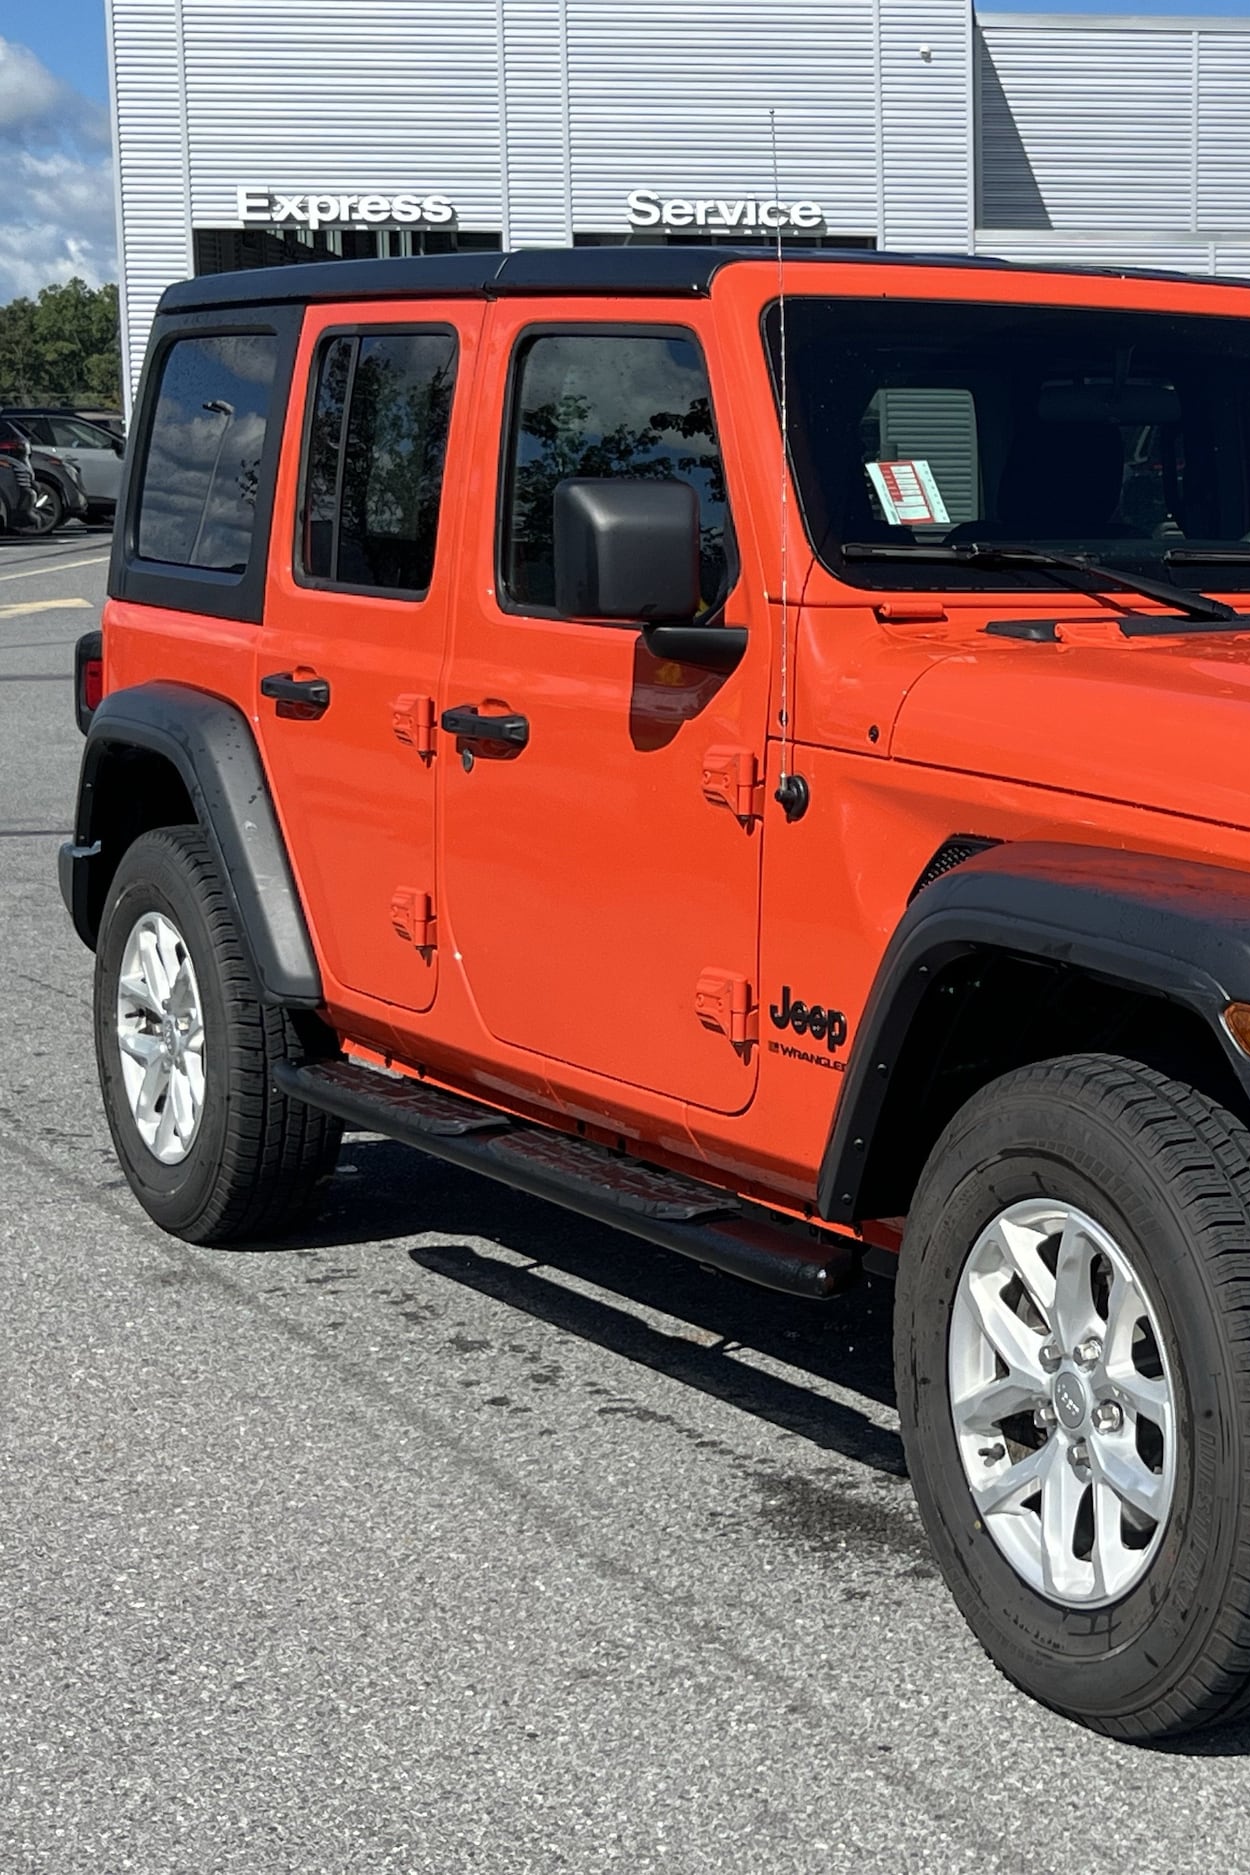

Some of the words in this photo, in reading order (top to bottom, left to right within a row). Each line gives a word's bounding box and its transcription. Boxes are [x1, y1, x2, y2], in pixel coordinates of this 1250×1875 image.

[236, 185, 453, 229] Express
[626, 189, 822, 227] Service
[769, 985, 847, 1053] Jeep
